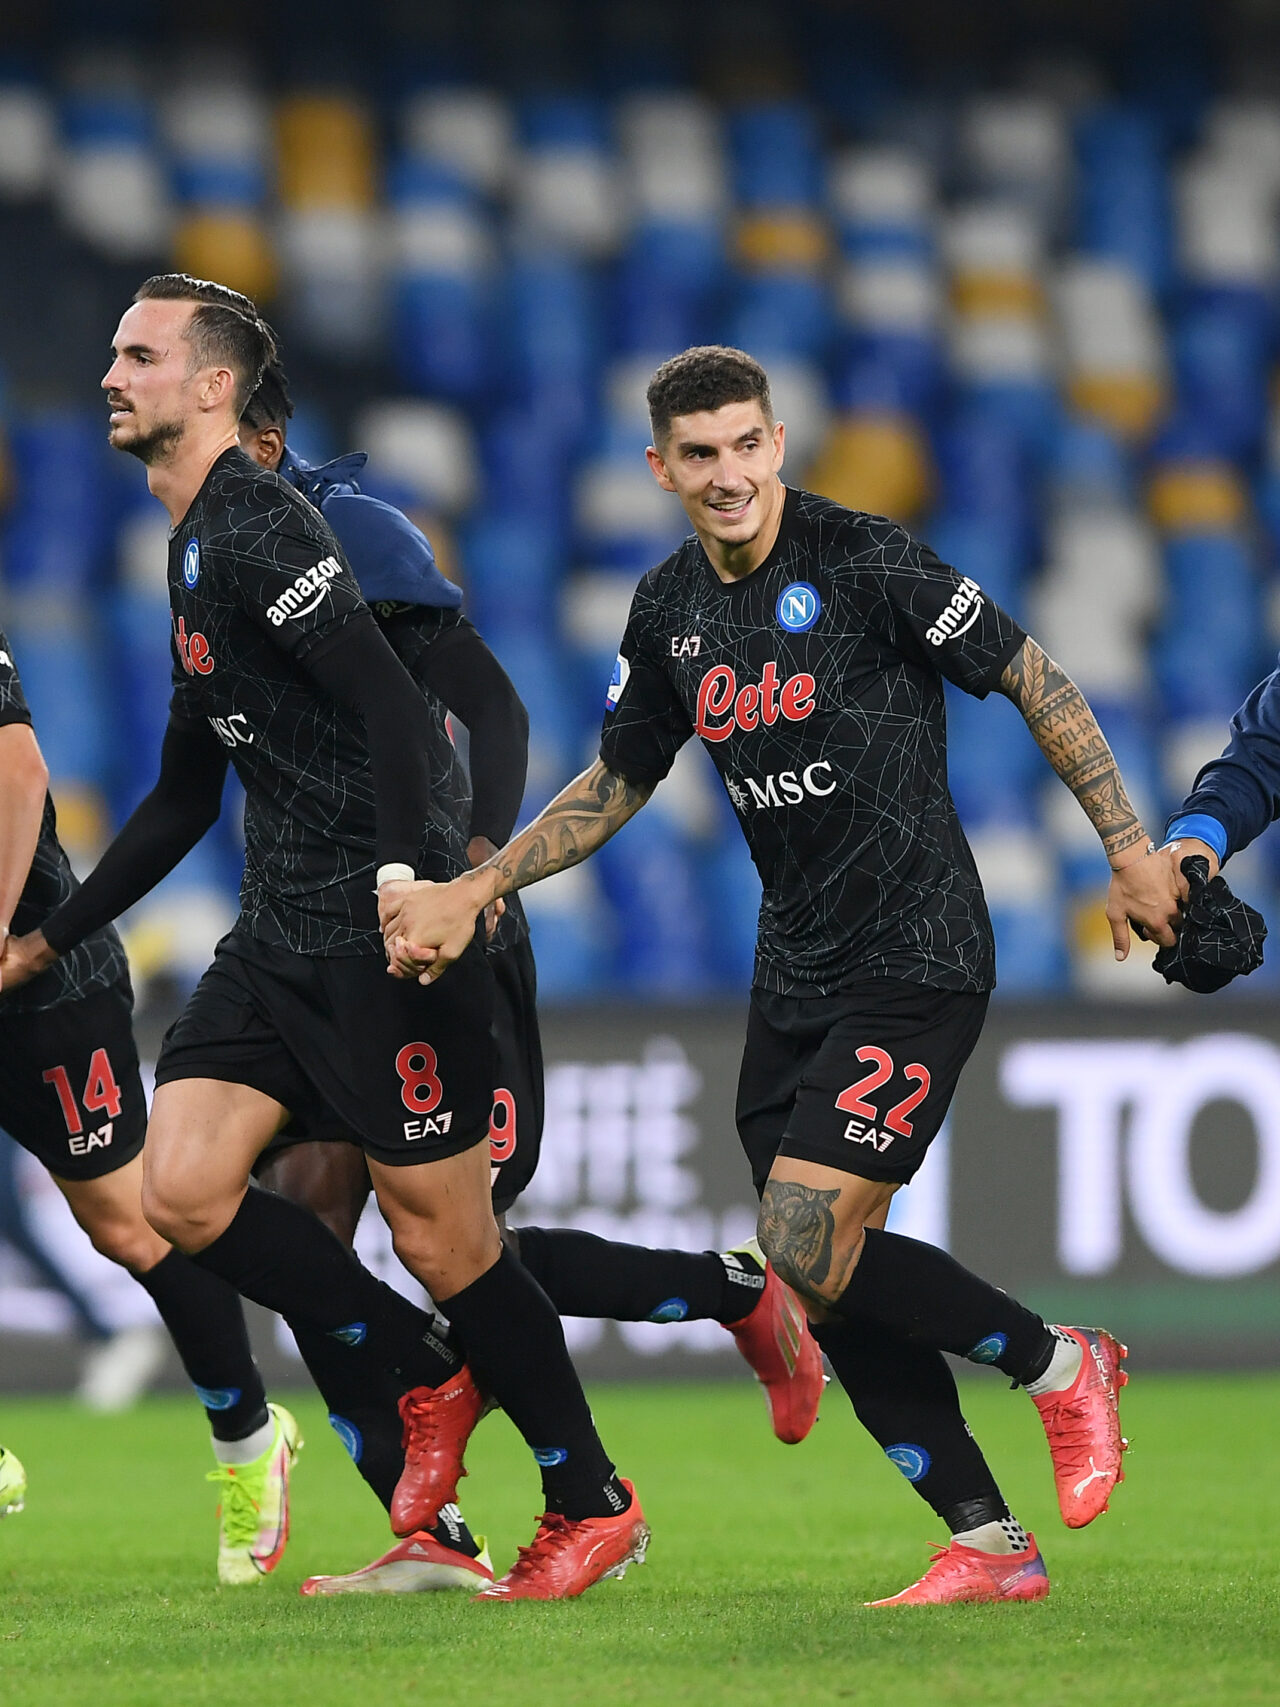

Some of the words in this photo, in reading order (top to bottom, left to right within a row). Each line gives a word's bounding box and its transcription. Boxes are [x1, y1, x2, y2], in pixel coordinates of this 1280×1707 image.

[266, 555, 343, 627] amazon
[787, 594, 808, 620] N
[926, 577, 981, 646] amazo
[172, 610, 214, 676] te
[671, 635, 701, 658] EA7
[694, 661, 817, 743] Lete
[743, 760, 837, 810] MSC
[42, 1047, 122, 1134] 14
[395, 1041, 443, 1114] 8
[834, 1045, 931, 1138] 22
[68, 1122, 114, 1156] EA7
[403, 1111, 453, 1141] EA7
[843, 1119, 895, 1152] EA7
